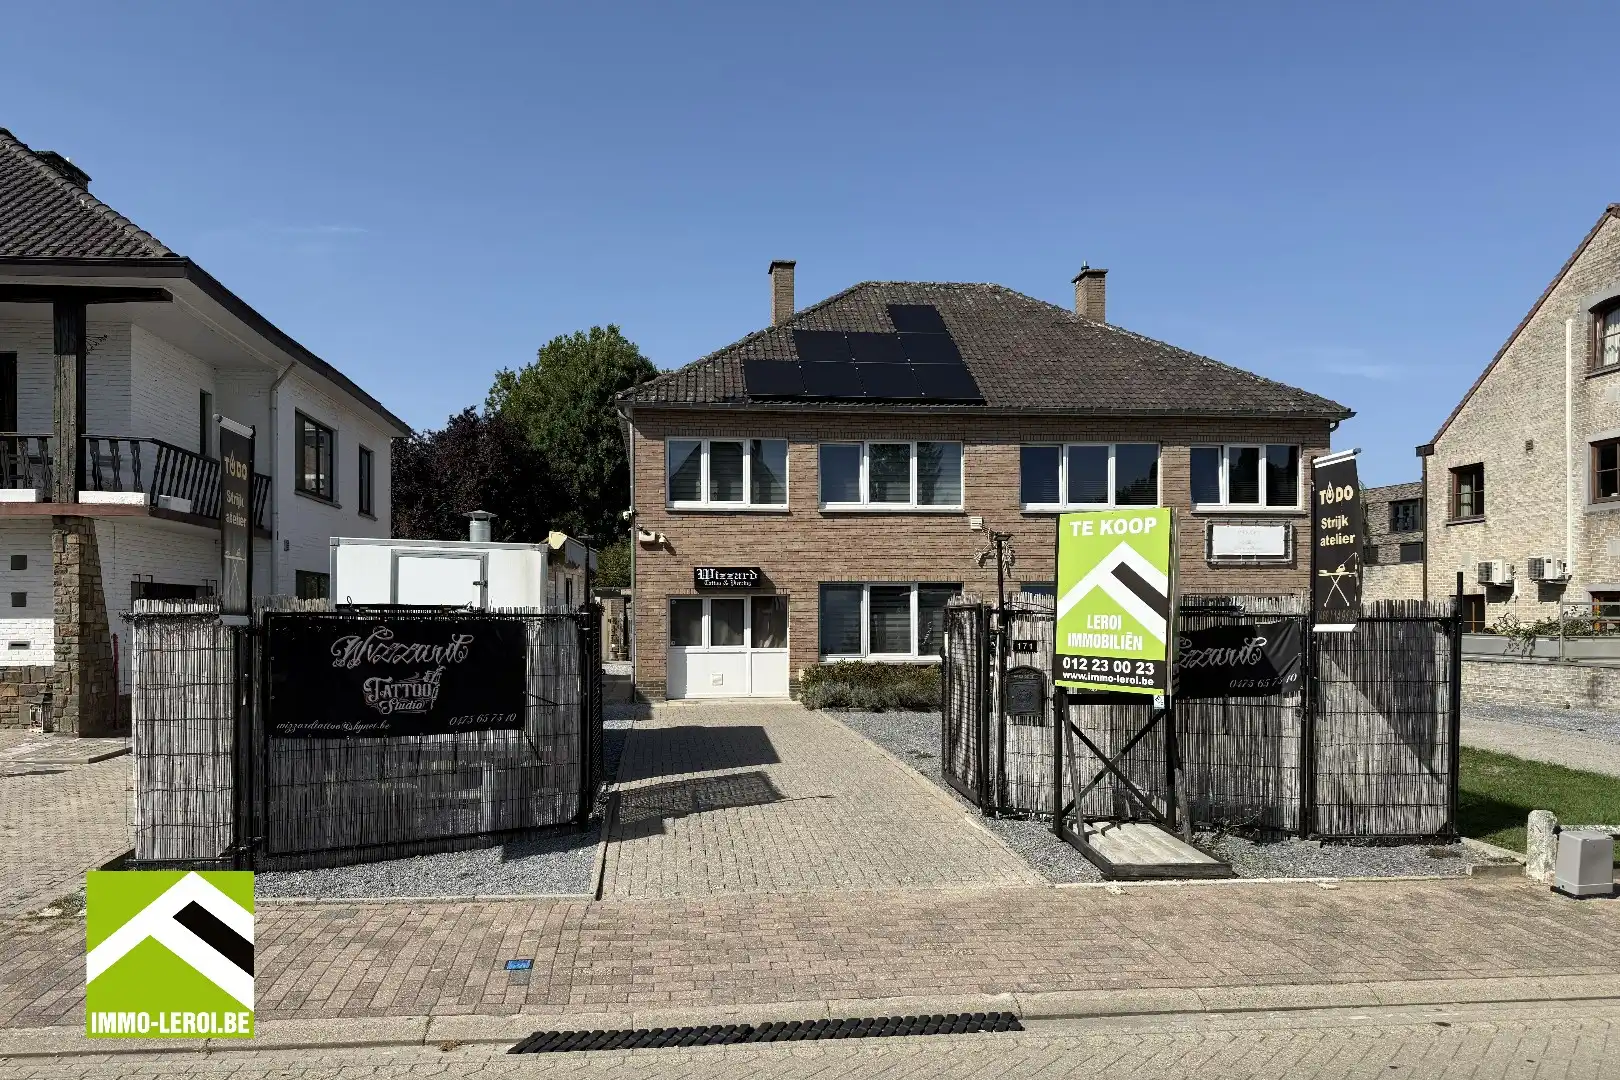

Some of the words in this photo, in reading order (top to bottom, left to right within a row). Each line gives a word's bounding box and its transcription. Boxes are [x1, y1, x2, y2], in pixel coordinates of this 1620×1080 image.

[226, 489, 246, 509] Strijk
[1319, 481, 1354, 505] TODO
[225, 512, 248, 528] atelier
[1069, 520, 1094, 537] TE
[1100, 517, 1158, 536] KOOP
[1320, 514, 1349, 532] Strijk
[1319, 533, 1356, 547] atelier
[696, 568, 758, 580] Wizzard
[1087, 614, 1122, 630] LEROI
[330, 625, 474, 669] Wizzard
[1017, 642, 1033, 650] 171
[1067, 632, 1143, 651] IMMOBILIËN
[1062, 657, 1088, 671] 012
[1091, 658, 1109, 672] 23
[1113, 660, 1131, 674] 00
[1135, 661, 1155, 675] 23
[1062, 672, 1155, 686] www.immo-leroi.be
[1229, 679, 1255, 688] 0475
[1257, 678, 1271, 688] 65
[1285, 672, 1298, 684] 10
[379, 698, 423, 715] Studio
[449, 715, 474, 726] 0475
[476, 713, 490, 723] 65
[505, 712, 517, 722] 10
